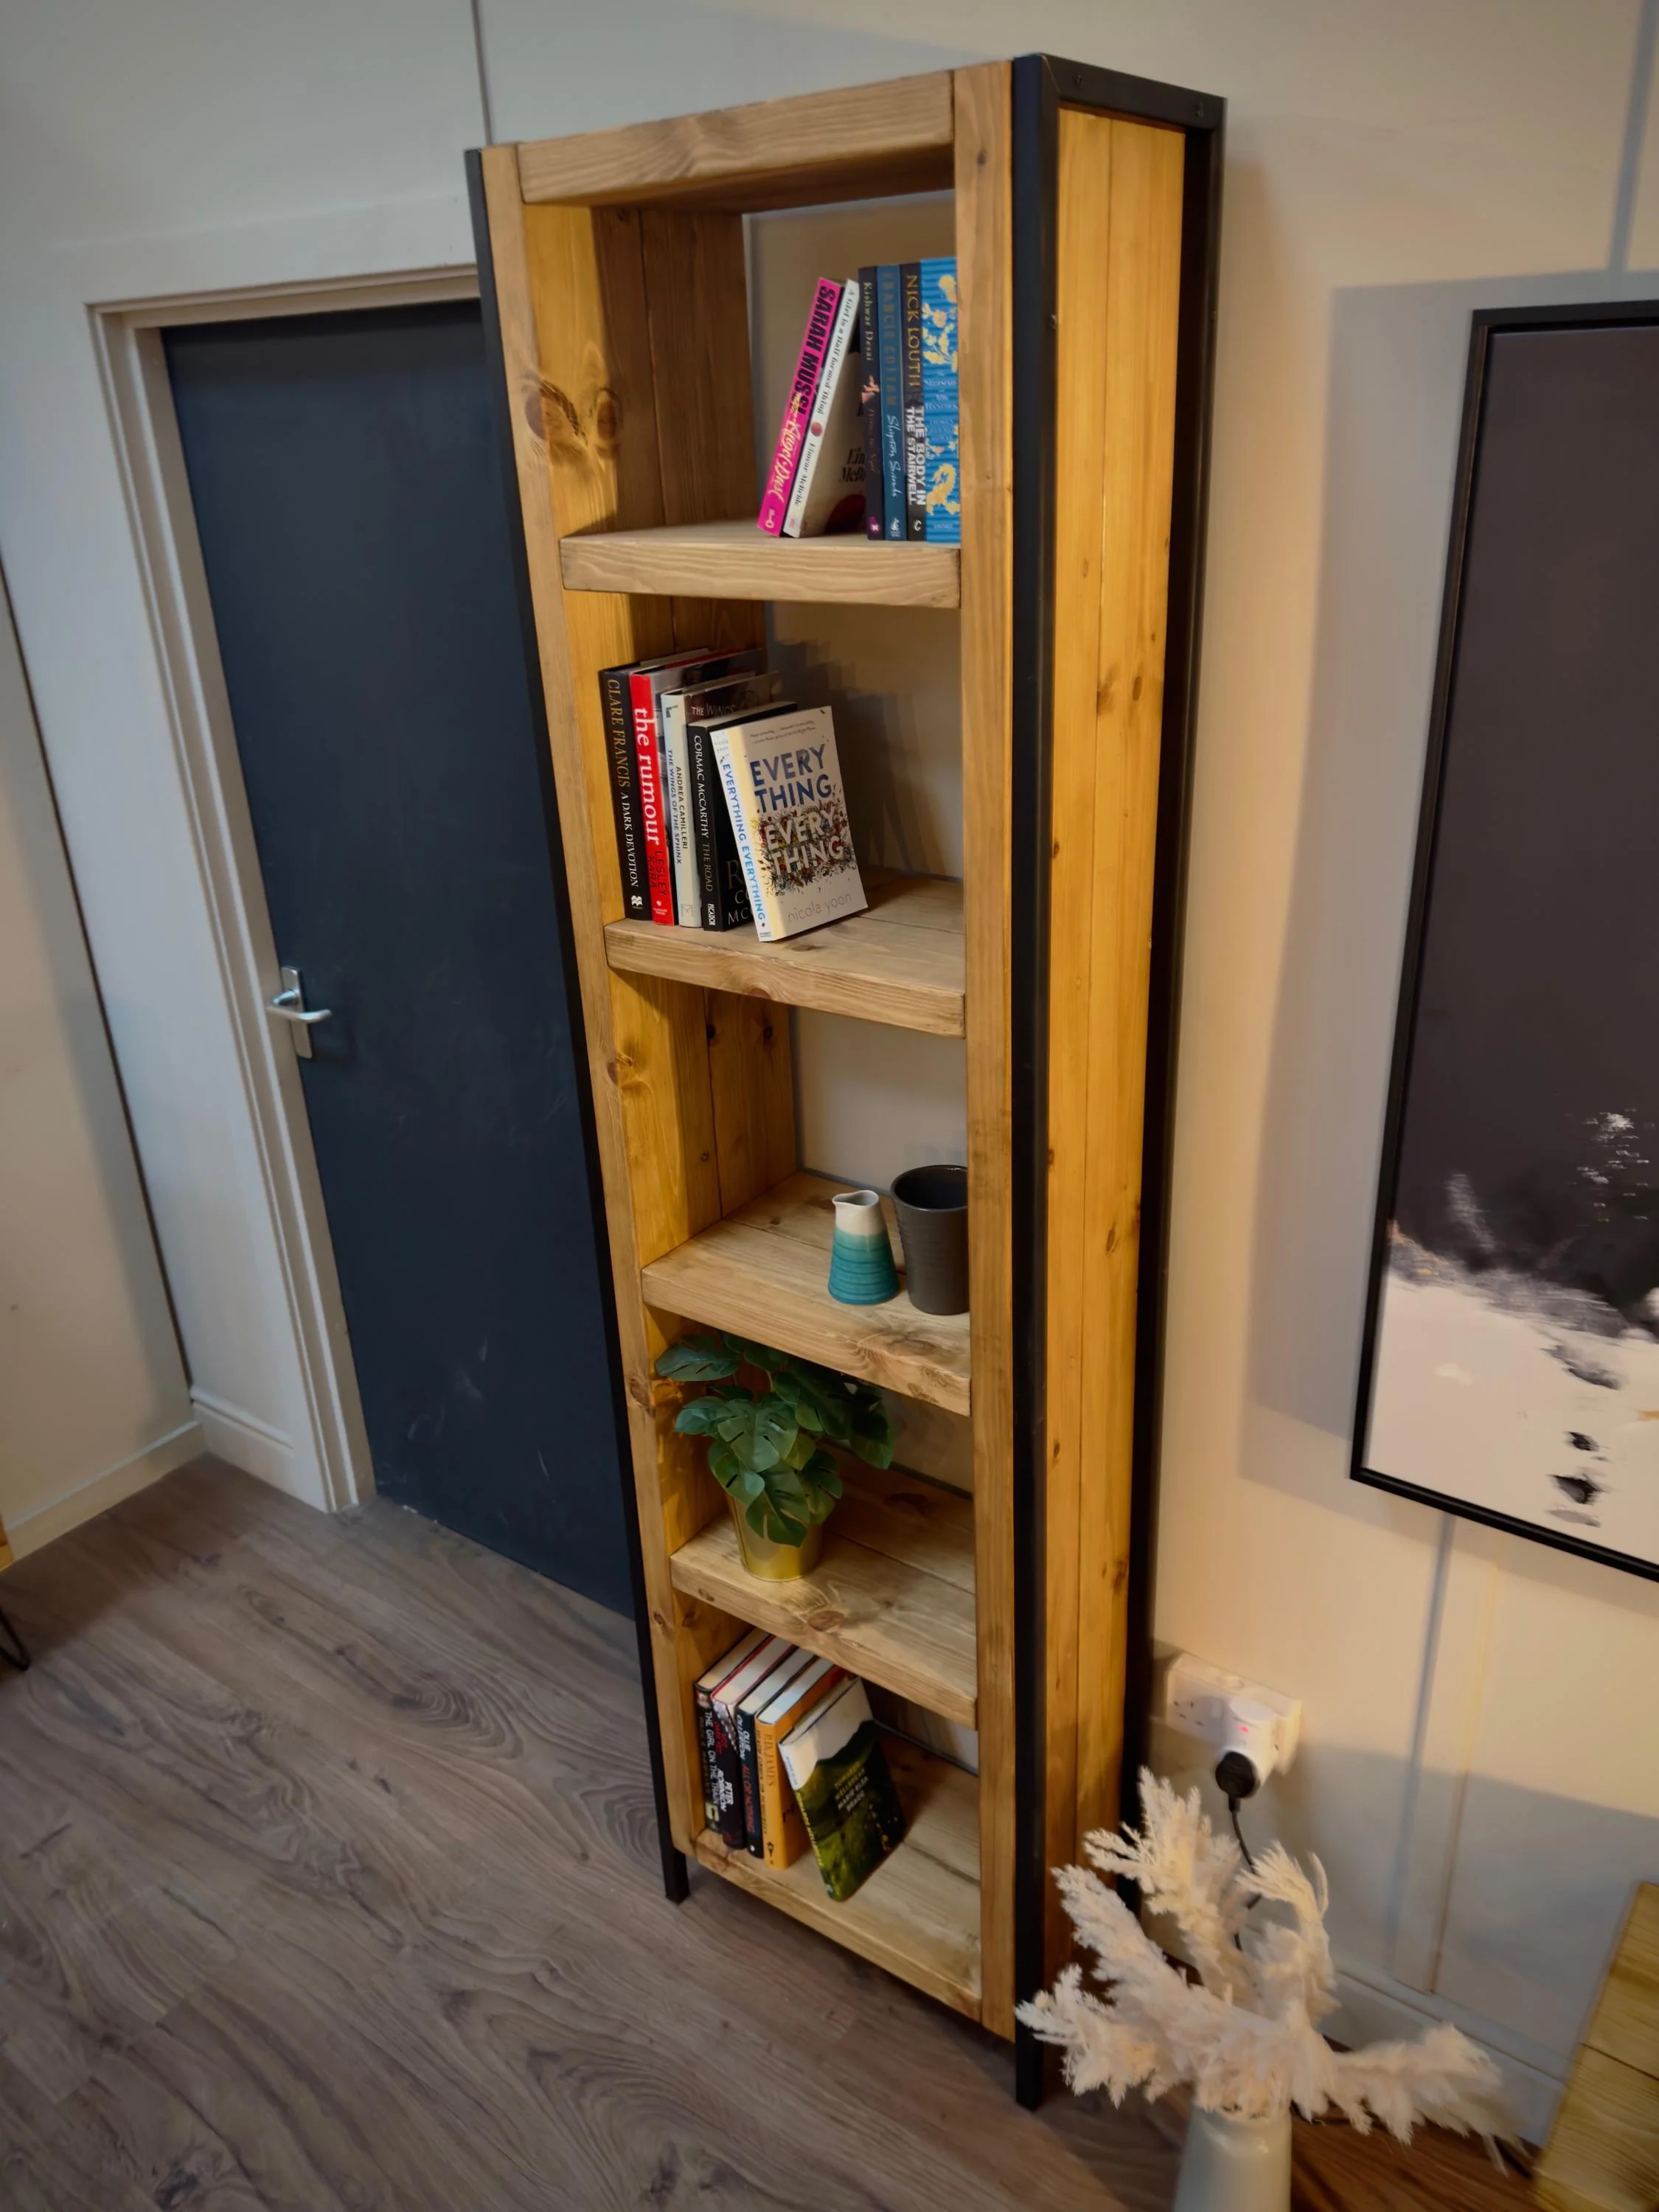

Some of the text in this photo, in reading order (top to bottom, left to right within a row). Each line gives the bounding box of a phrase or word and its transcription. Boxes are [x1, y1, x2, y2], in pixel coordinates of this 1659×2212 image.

[805, 285, 835, 352] SARAH
[863, 282, 874, 361] Kishwar Desai
[905, 274, 921, 387] NICK LOUTH
[906, 407, 917, 506] THE STAIRWELL
[914, 406, 927, 506] THE BODY IN
[691, 706, 704, 716] THE
[608, 679, 631, 787] CLARE FRANCIS
[634, 707, 659, 846] the rumour
[694, 735, 705, 782] CORMAC
[750, 743, 825, 787] EVERY
[672, 801, 678, 812] OF
[675, 766, 688, 849] ANDREA CAMILLERI
[754, 774, 832, 813] THING
[621, 792, 639, 888] A DARK DEVOTION
[674, 832, 682, 864] SPHINX
[765, 806, 836, 850] EVERY
[648, 855, 656, 888] KARA
[655, 851, 667, 896] LESLEY
[702, 843, 713, 892] THE ROAD
[771, 835, 844, 877] THING
[742, 846, 766, 920] EVERYTHING
[707, 903, 716, 926] PICADOR
[787, 893, 852, 922] nicola yoon
[705, 1711, 714, 1727] THE
[706, 1730, 714, 1748] GIRL
[708, 1750, 717, 1762] ON
[742, 1730, 751, 1753] OLLIE
[709, 1765, 717, 1781] THE
[717, 1768, 727, 1812] ROBINSON
[742, 1764, 750, 1778] ALL
[765, 1753, 776, 1787] JAMES
[711, 1782, 720, 1805] TRAIN
[724, 1781, 734, 1806] PETER
